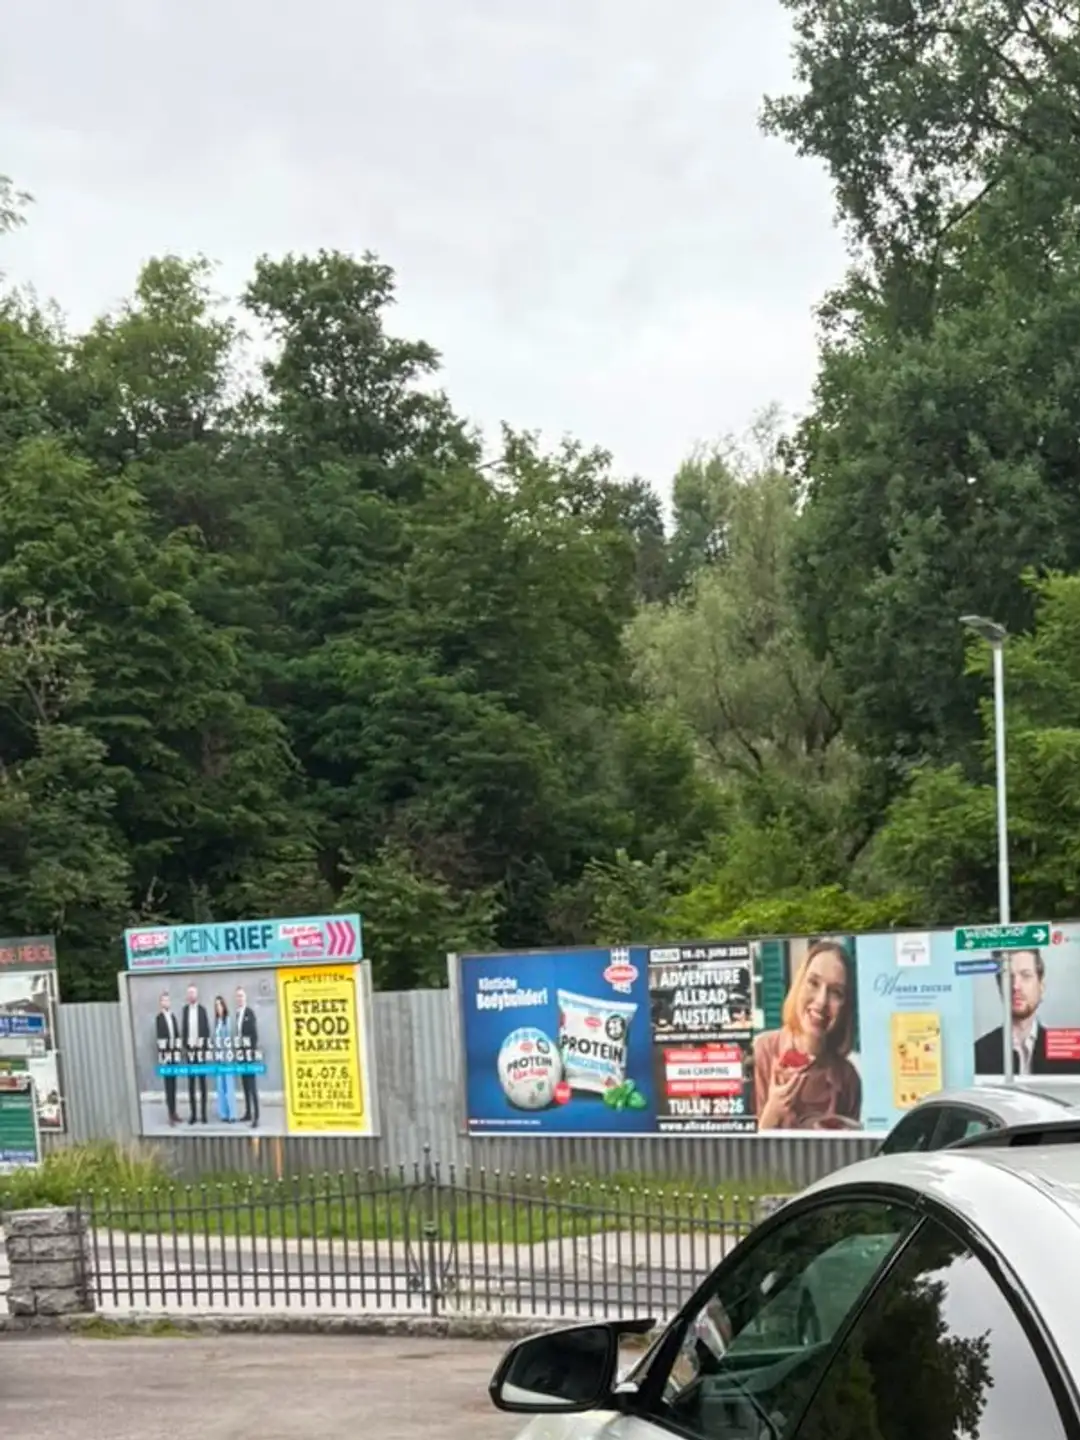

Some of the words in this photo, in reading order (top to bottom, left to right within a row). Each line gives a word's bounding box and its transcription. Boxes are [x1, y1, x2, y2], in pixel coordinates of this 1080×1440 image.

[224, 925, 273, 951] RIEF
[660, 968, 741, 988] ADVENTURE
[674, 988, 728, 1006] ALLRAD
[292, 999, 348, 1014] STREET
[672, 1006, 731, 1025] AUSTRIA
[294, 1016, 350, 1036] FOOD
[295, 1038, 350, 1052] MARKET
[561, 1035, 624, 1063] PROTEIN
[158, 1051, 181, 1064] IHR
[507, 1056, 552, 1073] PROTEIN
[668, 1098, 712, 1114] TULLN
